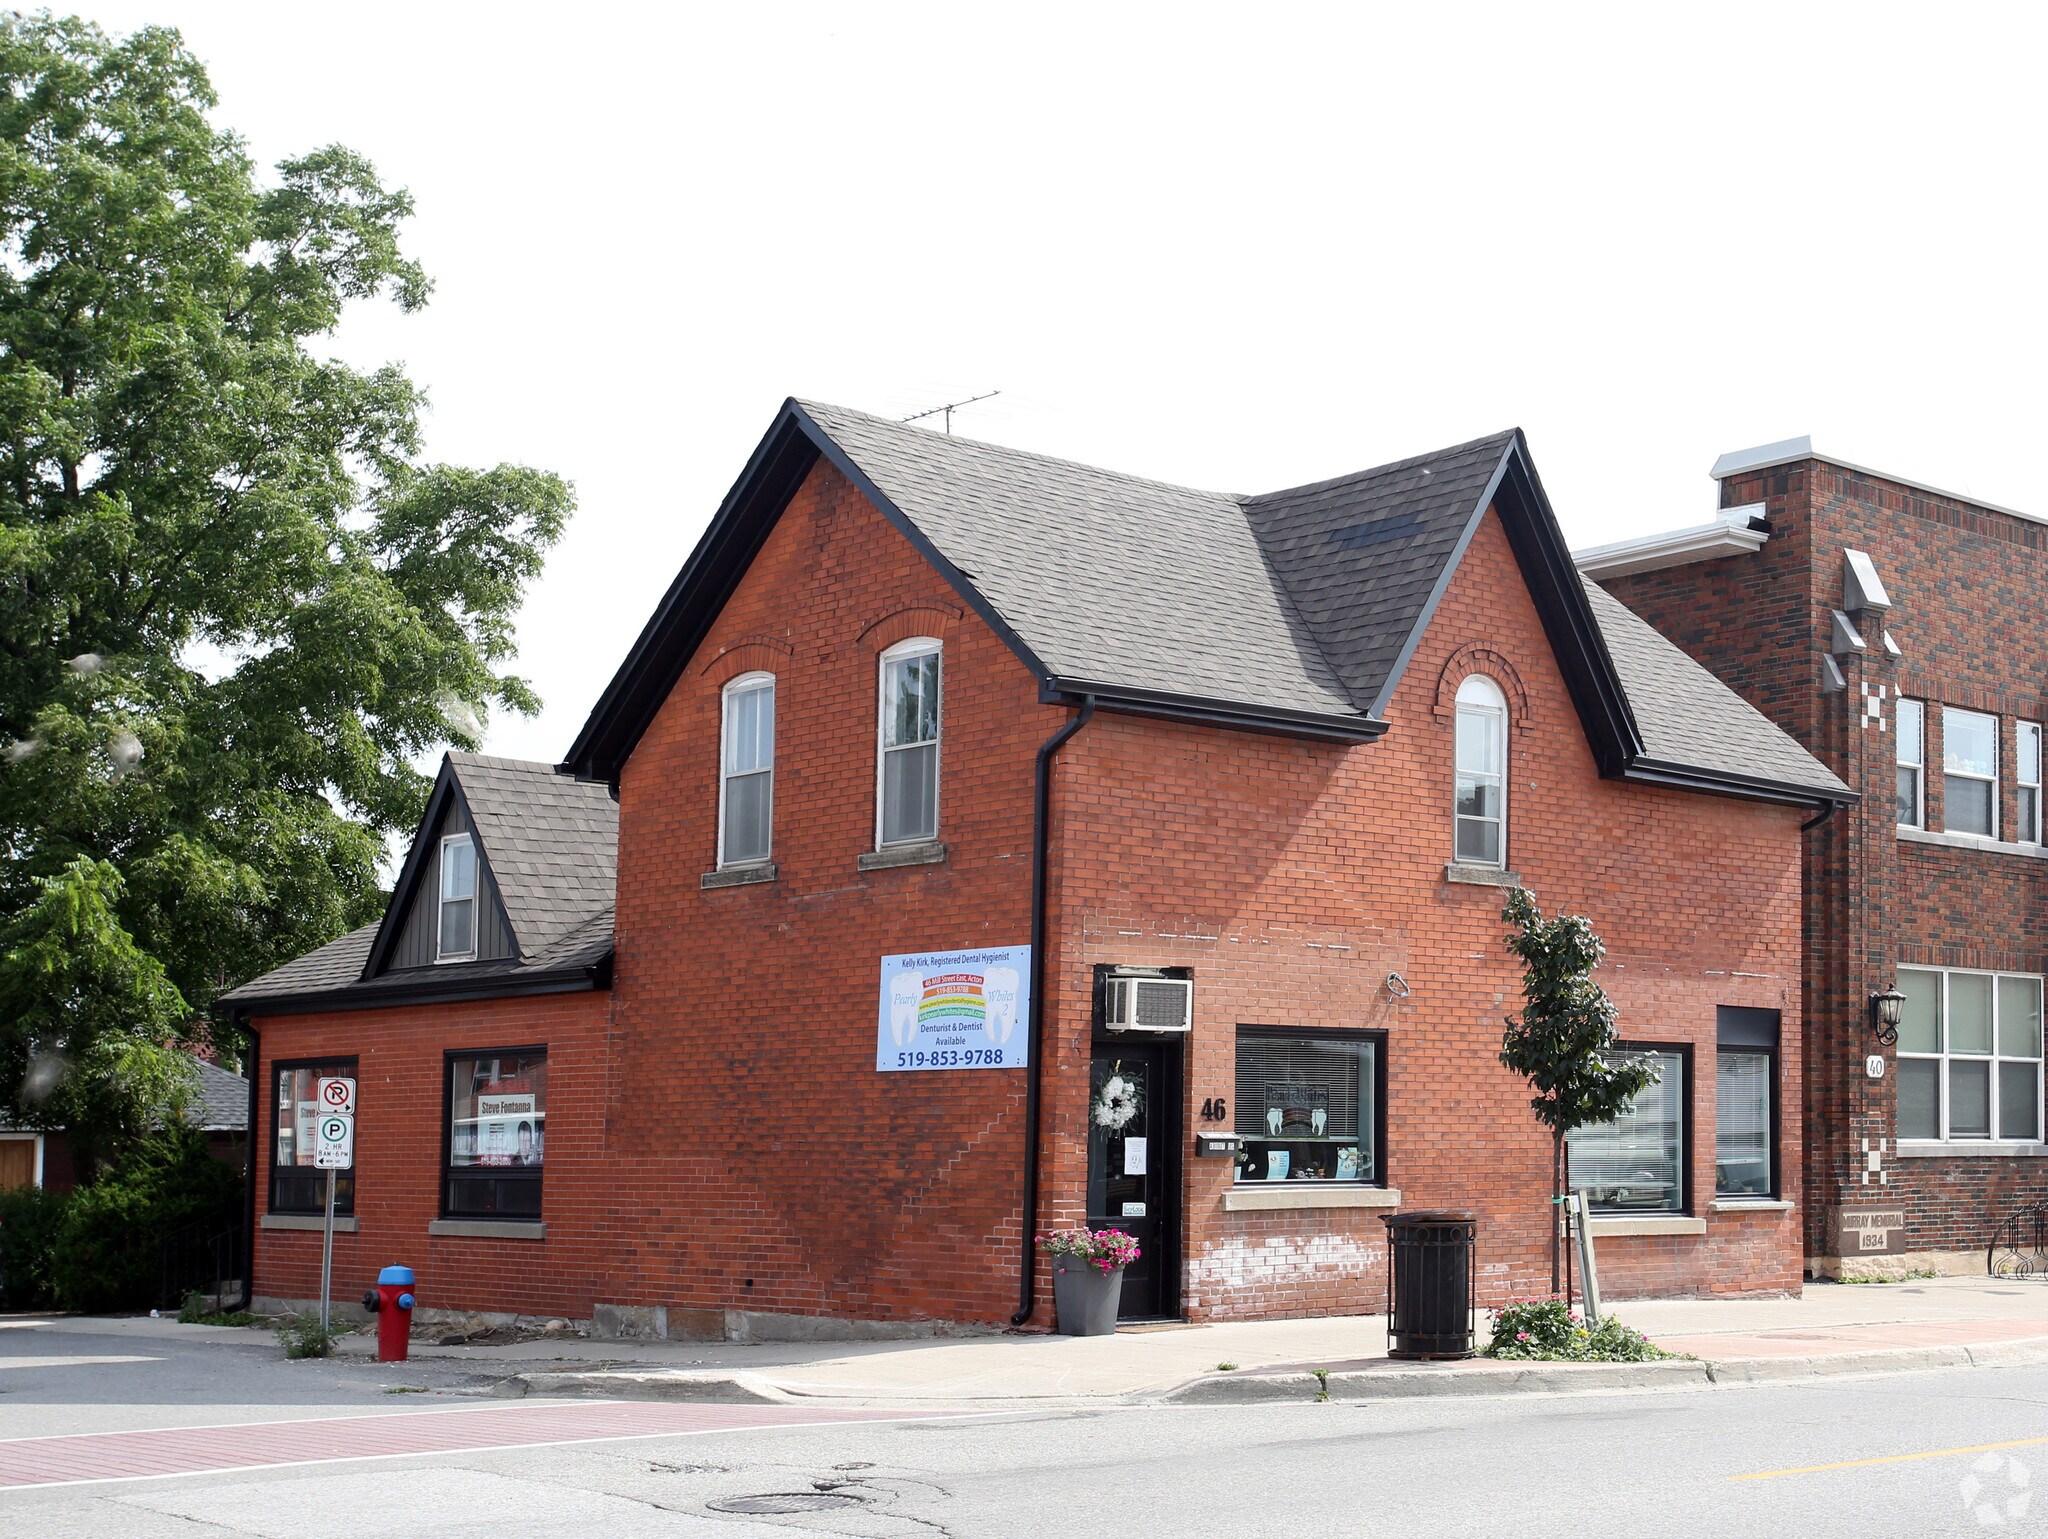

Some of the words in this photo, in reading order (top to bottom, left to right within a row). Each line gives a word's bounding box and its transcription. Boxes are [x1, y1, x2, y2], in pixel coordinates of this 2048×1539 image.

[902, 957, 916, 969] Kelly
[916, 957, 929, 968] Kirk,
[931, 955, 961, 967] Registered
[962, 953, 981, 964] Dental
[981, 952, 1010, 964] Hygienist
[931, 977, 941, 985] Mill
[941, 975, 956, 984] Street
[968, 975, 983, 984] Acton
[936, 986, 969, 995] 519-853-9788
[988, 989, 1015, 1002] Whites
[894, 992, 918, 1007] Pearly
[1002, 1004, 1009, 1016] 2
[920, 1023, 952, 1033] Denturist
[952, 1023, 957, 1032] &
[958, 1022, 983, 1032] Dentist
[935, 1036, 966, 1046] Available
[897, 1049, 1003, 1067] 519-853-9788
[1869, 1060, 1883, 1075] 40
[301, 1107, 316, 1119] Steve
[482, 1101, 500, 1114] Steve
[1201, 1098, 1226, 1121] 46
[1843, 1215, 1869, 1228] MURRAY
[1871, 1213, 1902, 1227] MEMORIAL
[1862, 1234, 1884, 1248] 1934
